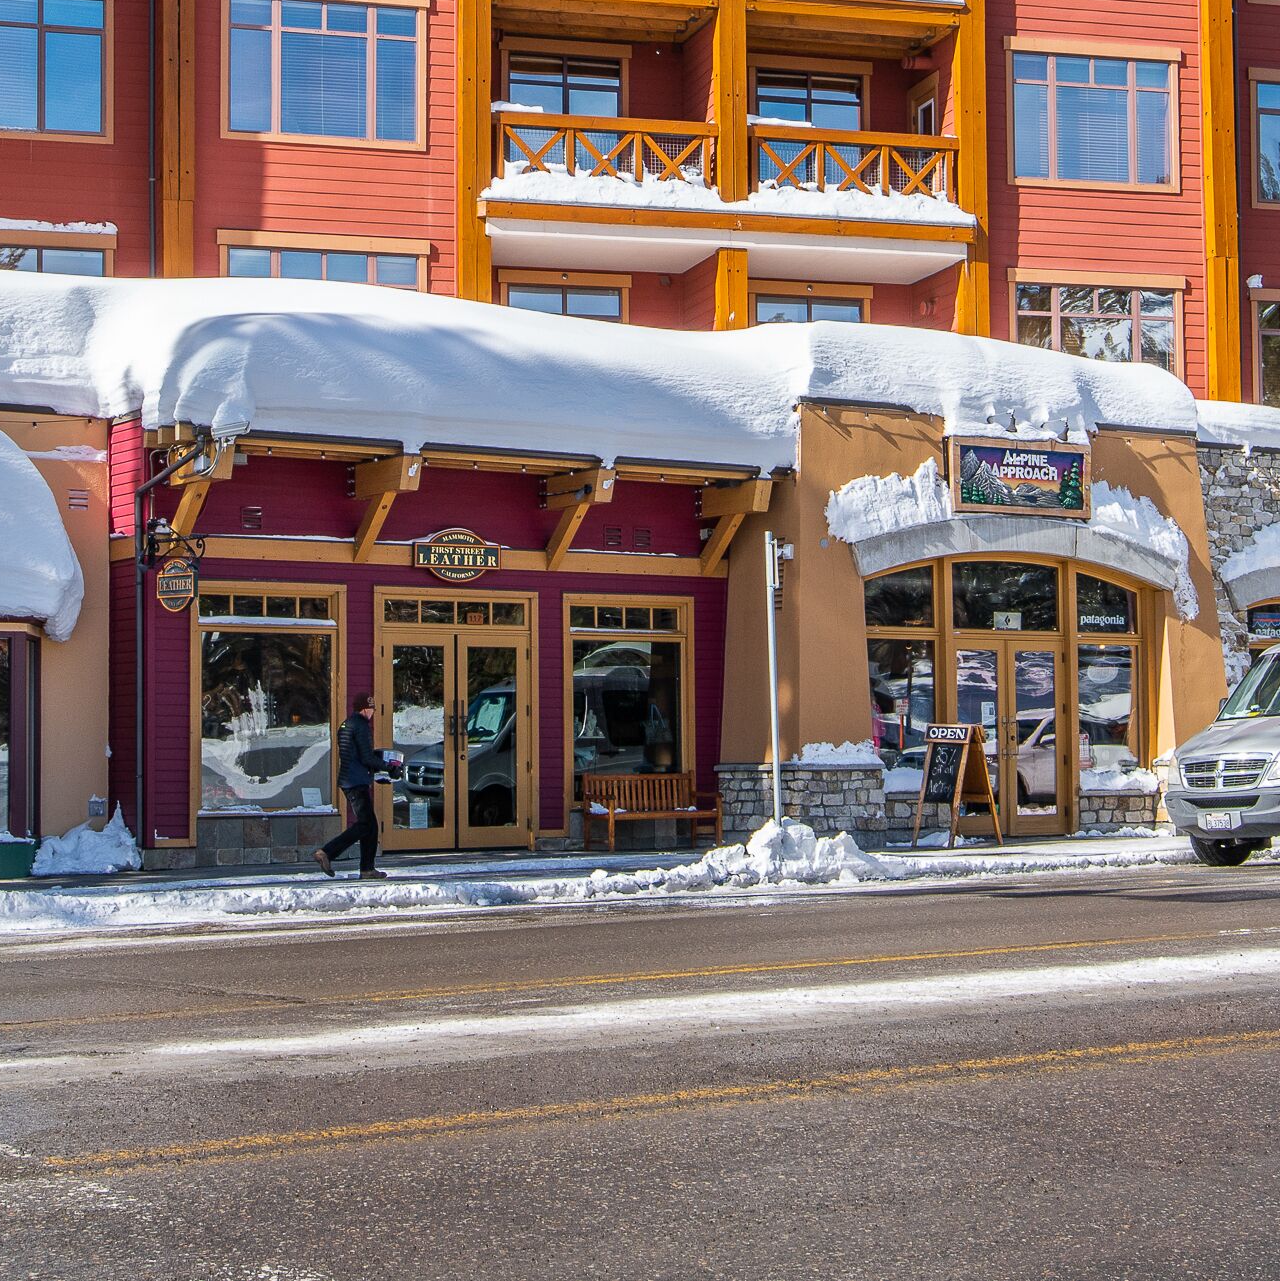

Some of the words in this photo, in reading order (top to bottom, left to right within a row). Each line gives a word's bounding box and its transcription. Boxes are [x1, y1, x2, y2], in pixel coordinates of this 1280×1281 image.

[1003, 450, 1048, 466] ALPINE
[991, 463, 1058, 480] APPROACH
[442, 534, 475, 544] MAMMOTH
[431, 546, 454, 554] FIRST
[455, 547, 485, 555] STREET
[419, 553, 497, 567] LEATHER
[441, 569, 475, 579] CALIFORNIA
[159, 579, 192, 591] LEATHER
[1080, 615, 1125, 626] patagonia
[929, 727, 966, 739] OPEN
[935, 746, 957, 765] 25%
